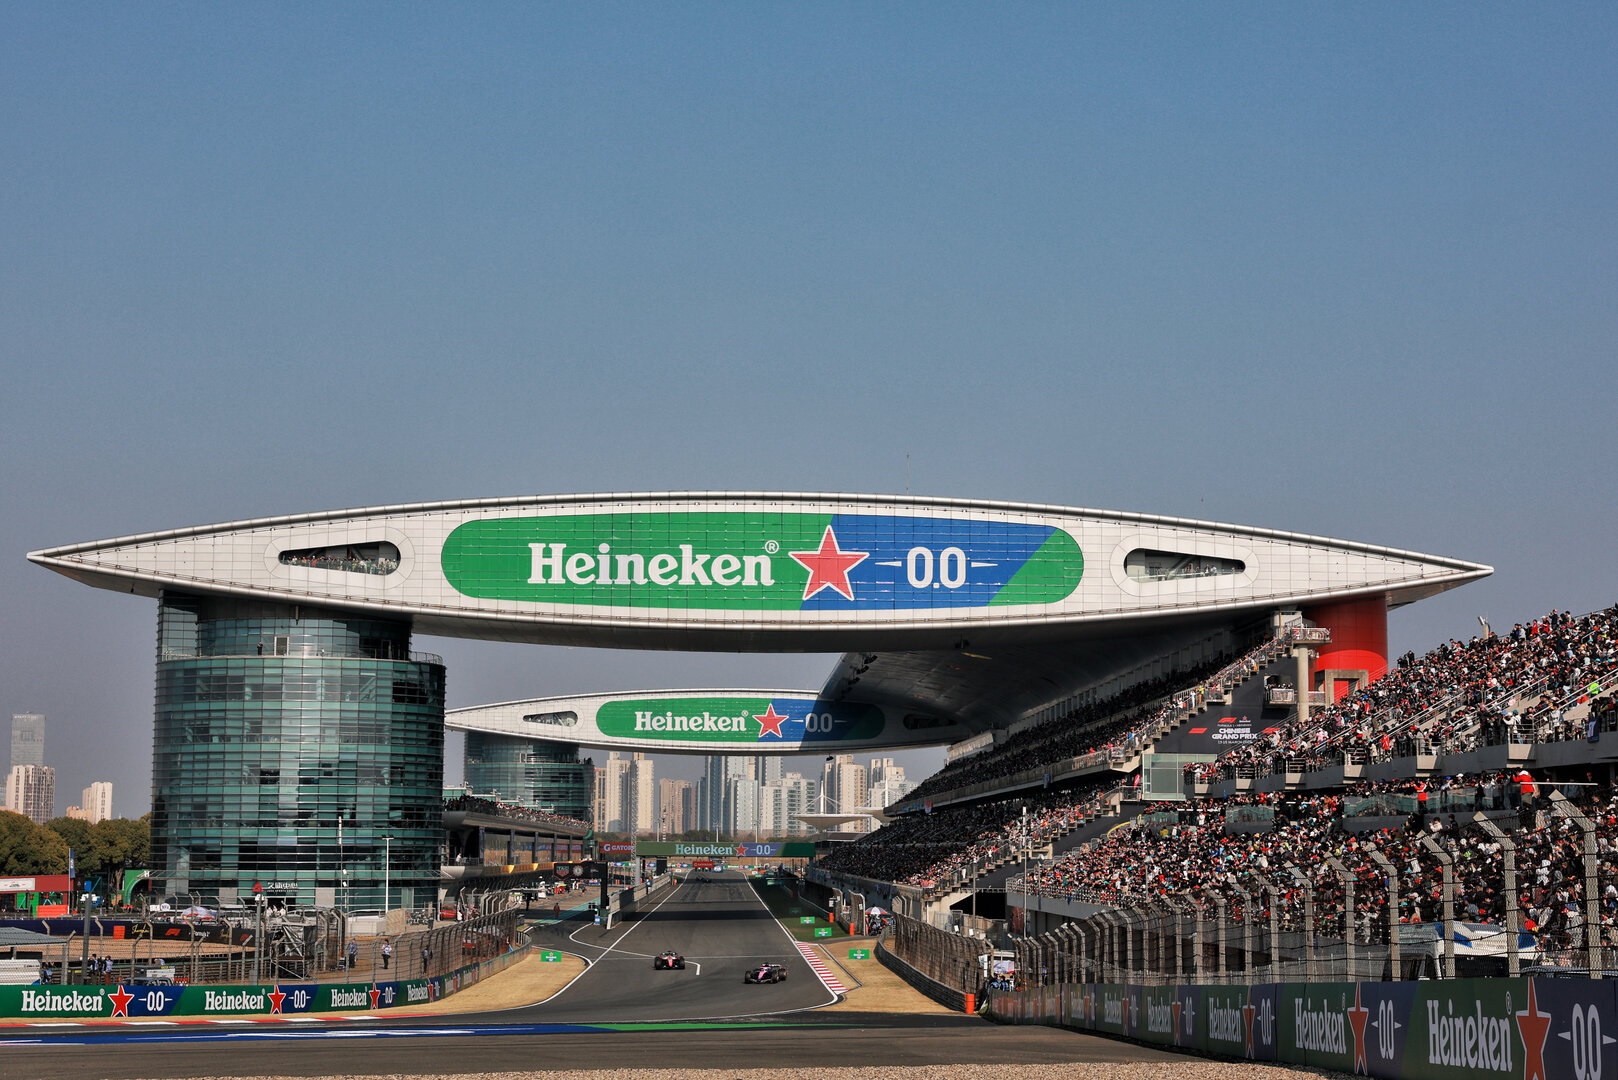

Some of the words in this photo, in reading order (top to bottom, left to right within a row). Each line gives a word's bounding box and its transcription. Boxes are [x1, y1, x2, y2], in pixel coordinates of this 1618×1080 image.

[528, 543, 775, 587] Heineken
[906, 546, 967, 589] 0.0
[634, 711, 746, 732] Heineken
[806, 712, 833, 733] 0.0
[675, 843, 733, 855] Heineken
[756, 844, 771, 855] 0.0
[21, 990, 103, 1012] Heineken
[147, 991, 164, 1011] 0.0
[205, 991, 264, 1010] Heineken
[293, 989, 306, 1009] 0.0
[331, 989, 367, 1007] Heineken
[407, 984, 429, 1001] Heineken
[1209, 997, 1241, 1043] Heineken
[1261, 998, 1271, 1046] 0.0
[1295, 997, 1346, 1054] Heineken
[1378, 1000, 1394, 1060] 0.0
[1427, 999, 1513, 1073] Heineken
[1571, 1003, 1601, 1080] 0.0
